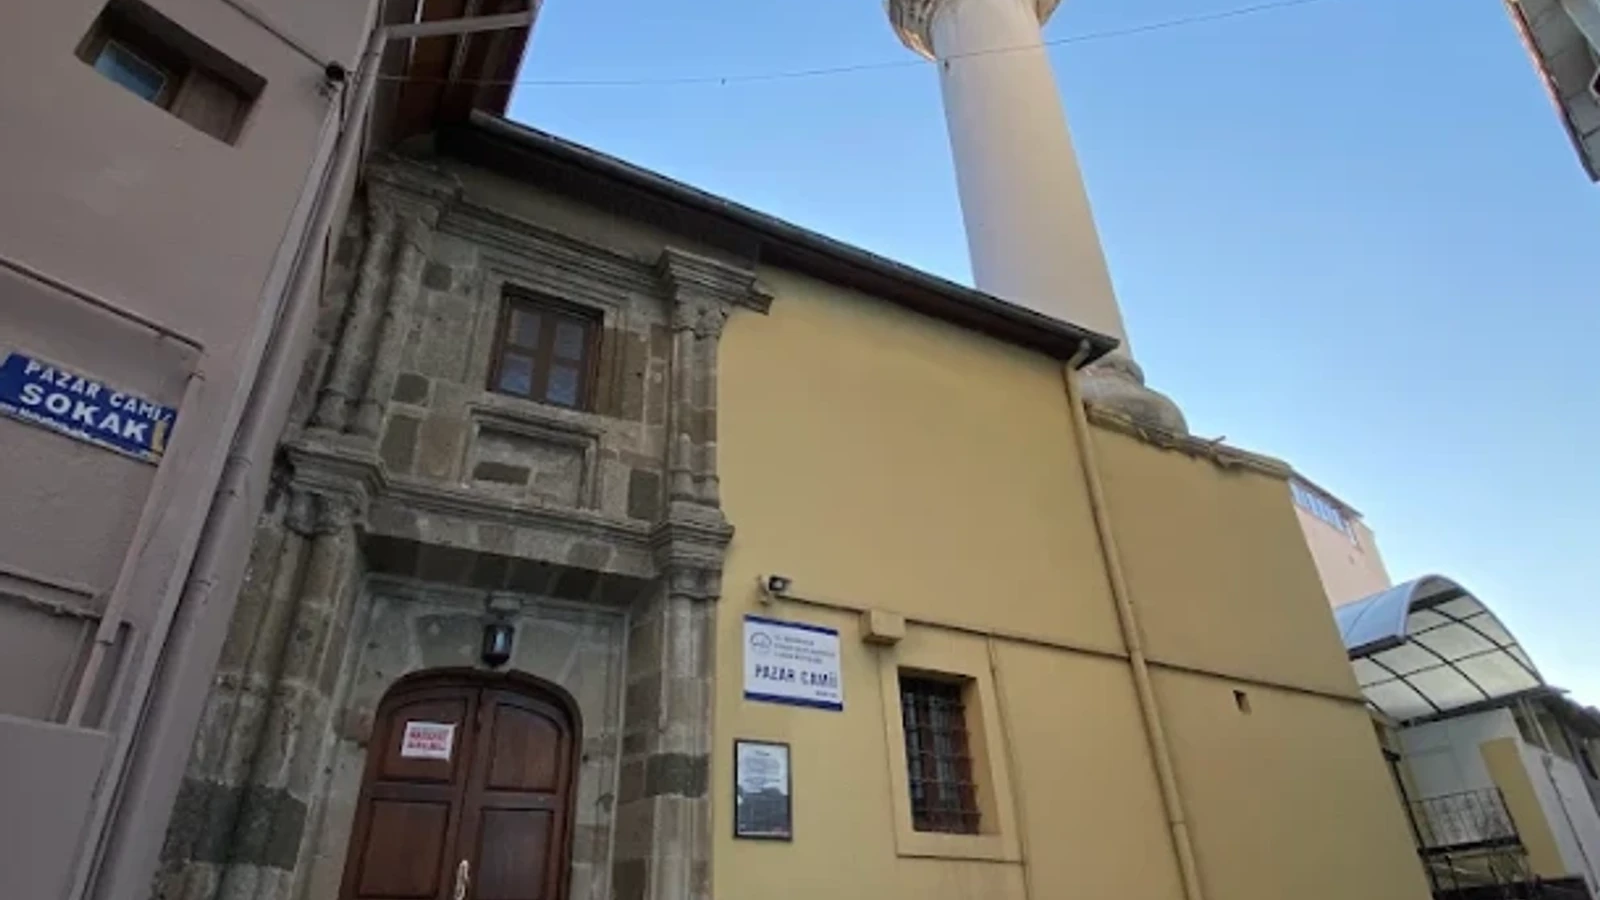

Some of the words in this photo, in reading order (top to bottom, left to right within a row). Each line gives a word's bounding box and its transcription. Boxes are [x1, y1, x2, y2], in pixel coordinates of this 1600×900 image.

[24, 359, 101, 399] PAZAR
[19, 382, 149, 443] SOKAK
[755, 664, 796, 683] PAZAR
